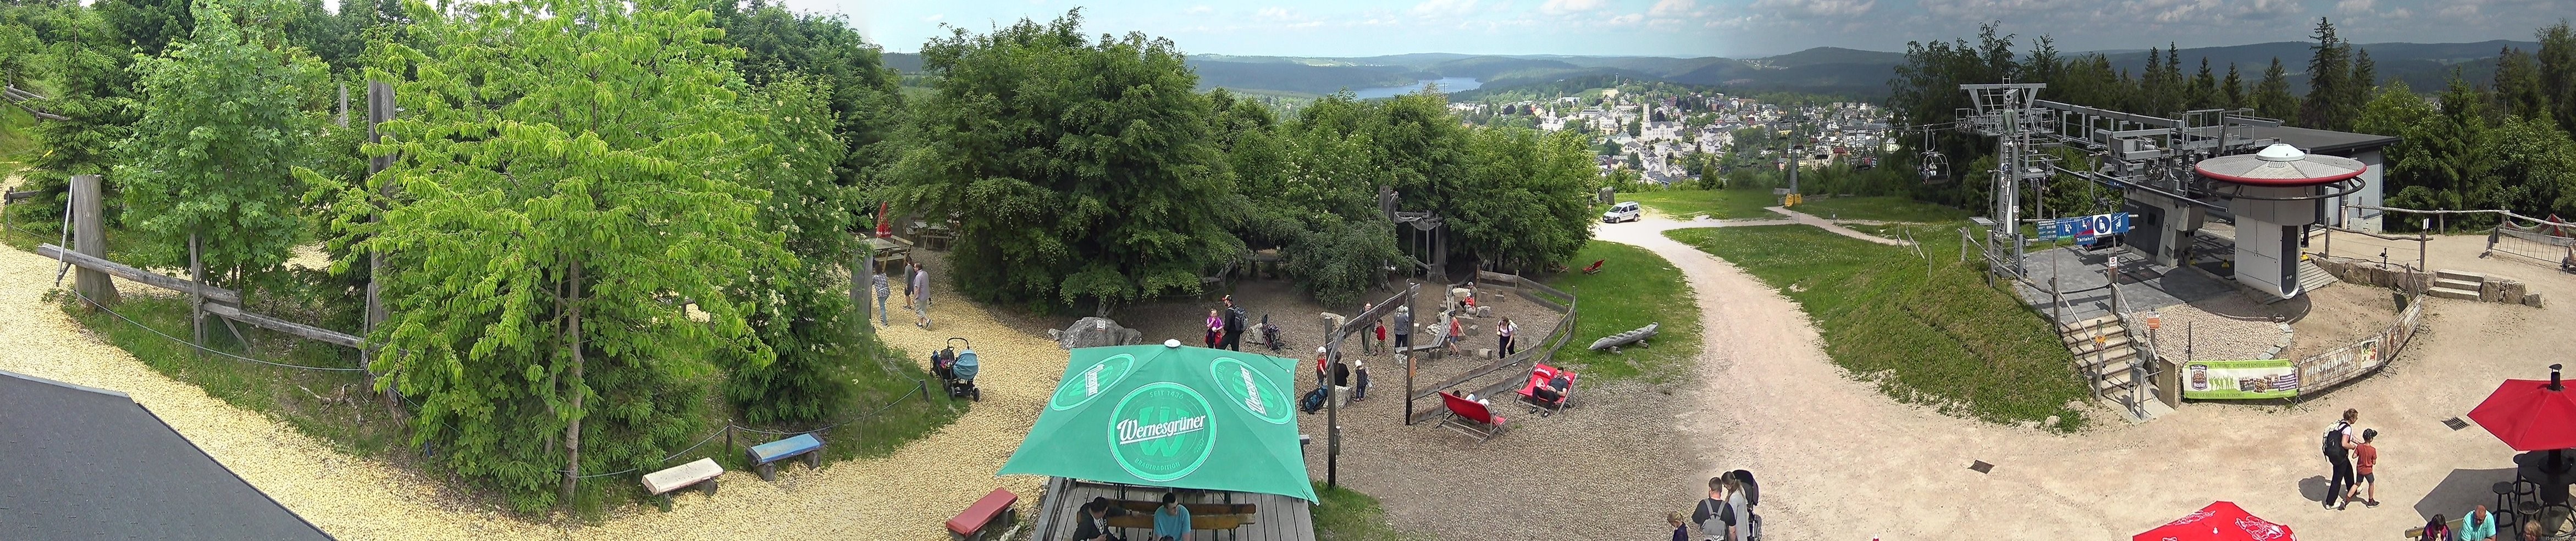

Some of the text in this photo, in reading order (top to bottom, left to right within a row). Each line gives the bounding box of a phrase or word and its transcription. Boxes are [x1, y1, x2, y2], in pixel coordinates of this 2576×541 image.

[2305, 352, 2354, 376] MURMELWALD
[1167, 390, 1184, 399] 1436
[1116, 415, 1206, 441] Wernesgrüner
[1135, 458, 1181, 471] BRAUTRADITION
